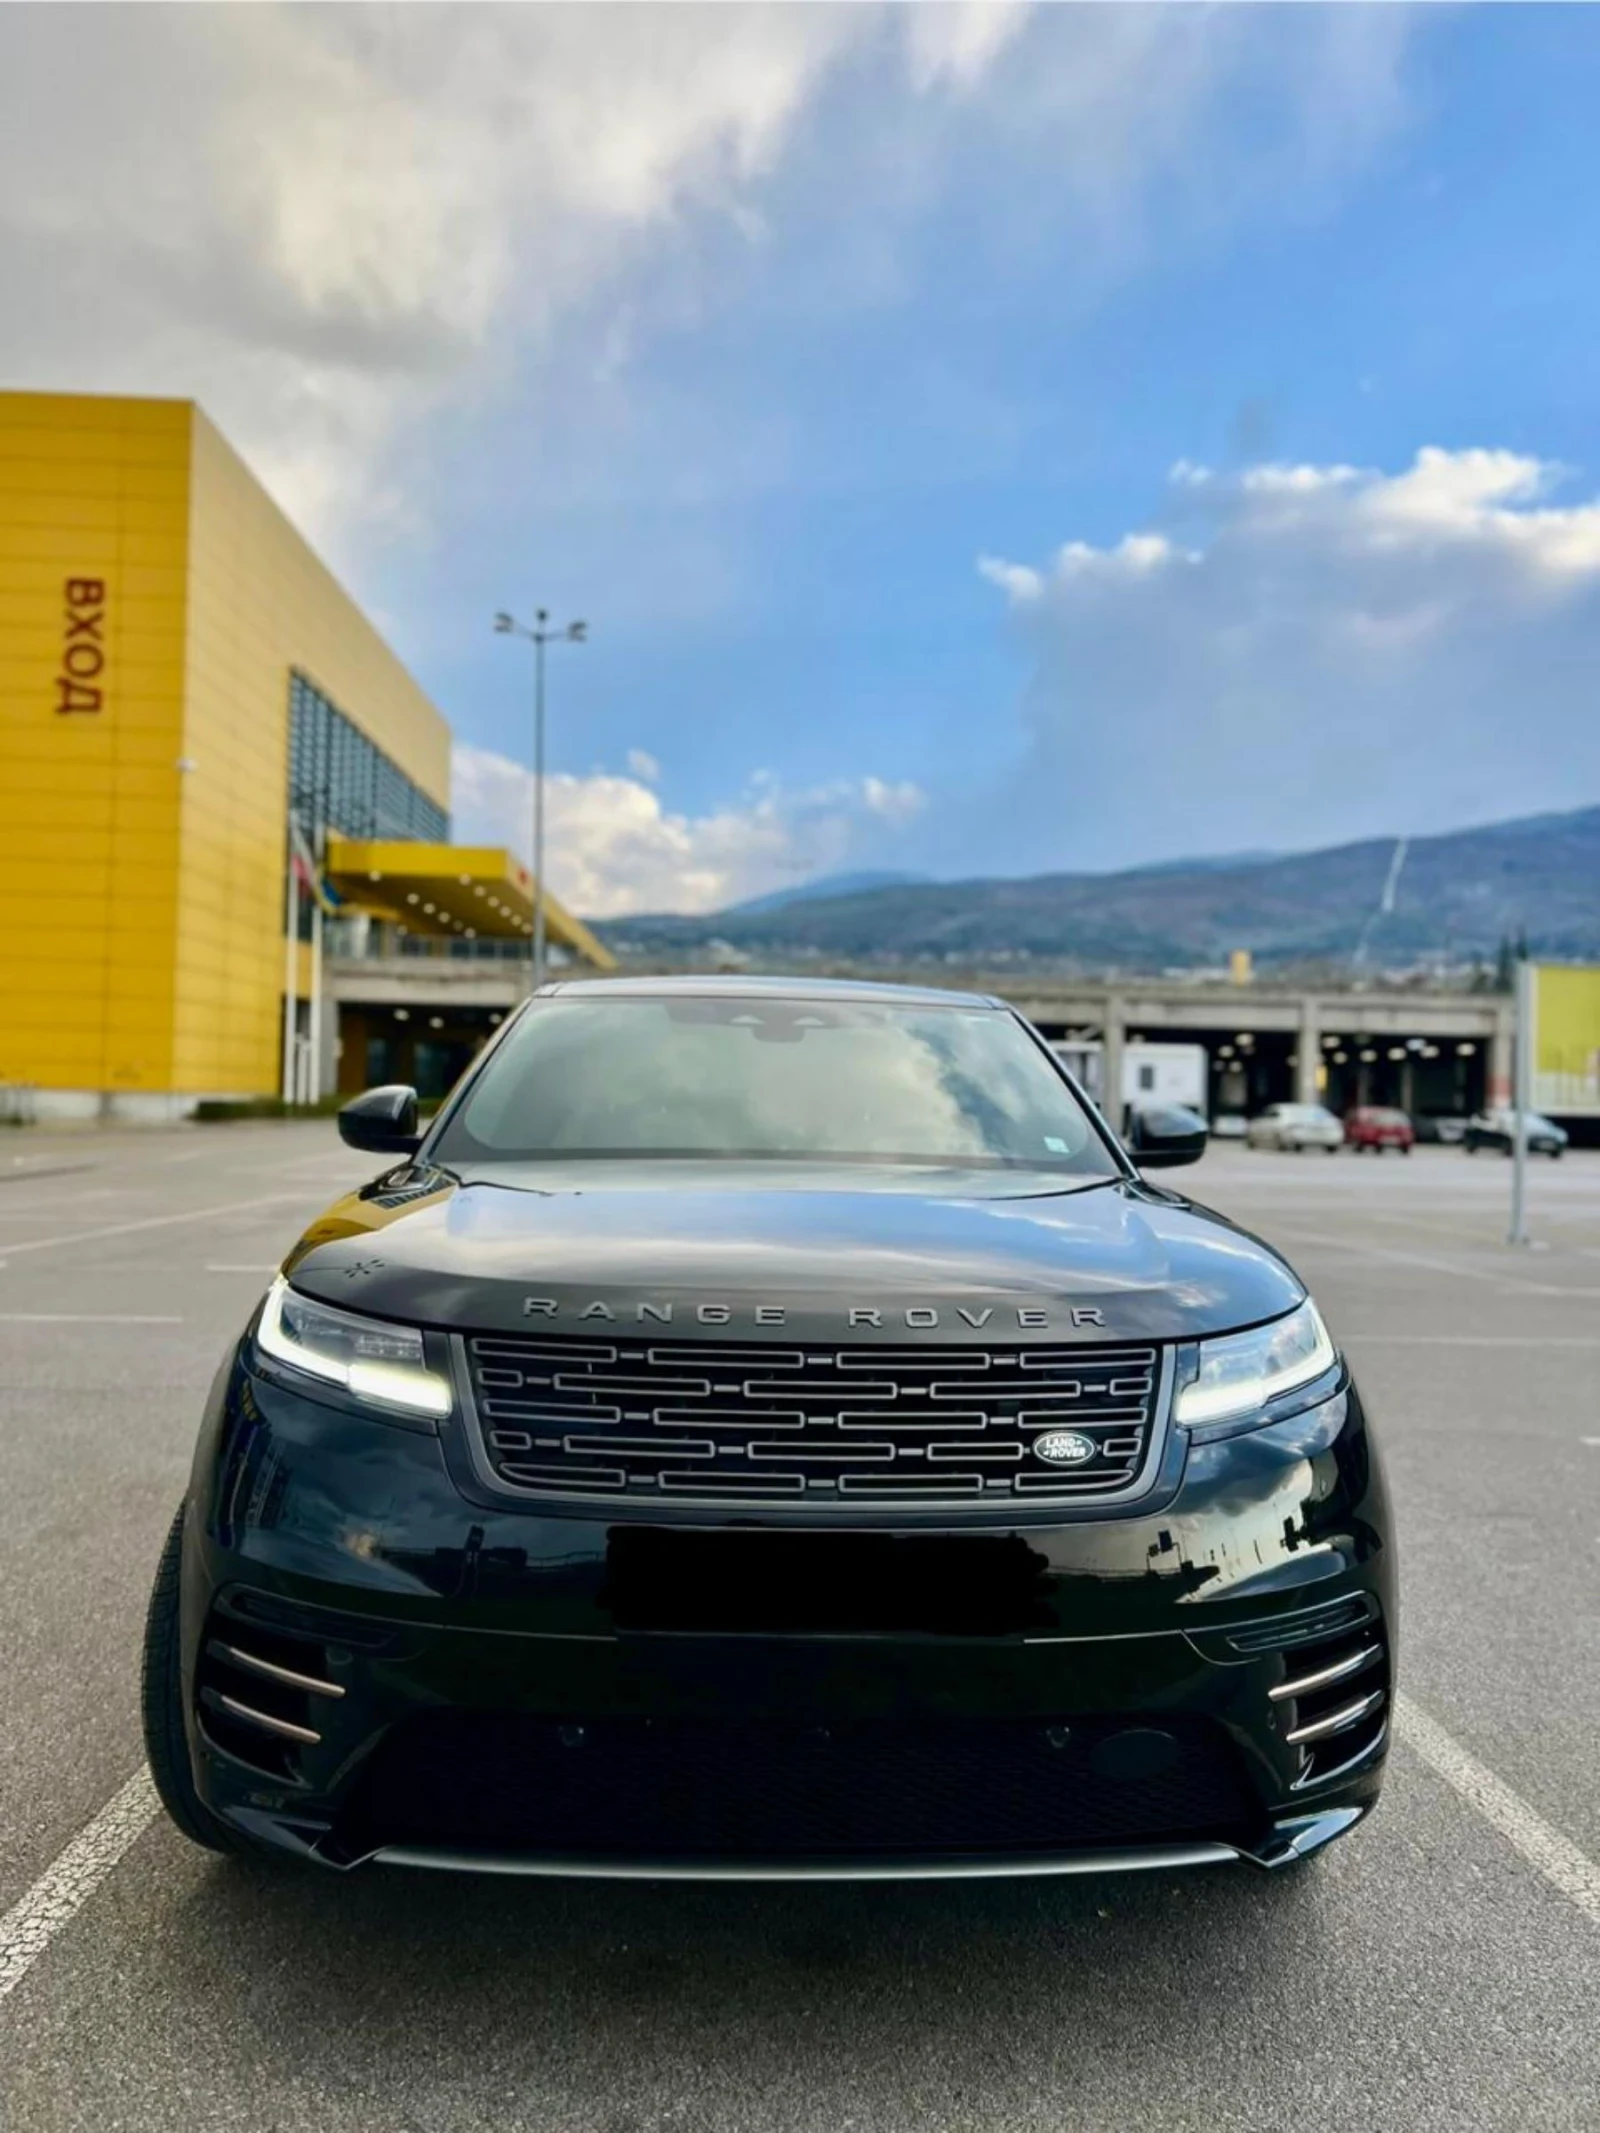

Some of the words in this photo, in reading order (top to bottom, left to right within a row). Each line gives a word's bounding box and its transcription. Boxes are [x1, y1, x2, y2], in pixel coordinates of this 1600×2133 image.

[56, 577, 104, 714] ВХОД
[523, 1297, 786, 1325] RANGE
[849, 1307, 1106, 1327] ROVER
[1046, 1437, 1076, 1448] LAND
[1050, 1447, 1086, 1458] ROVER
